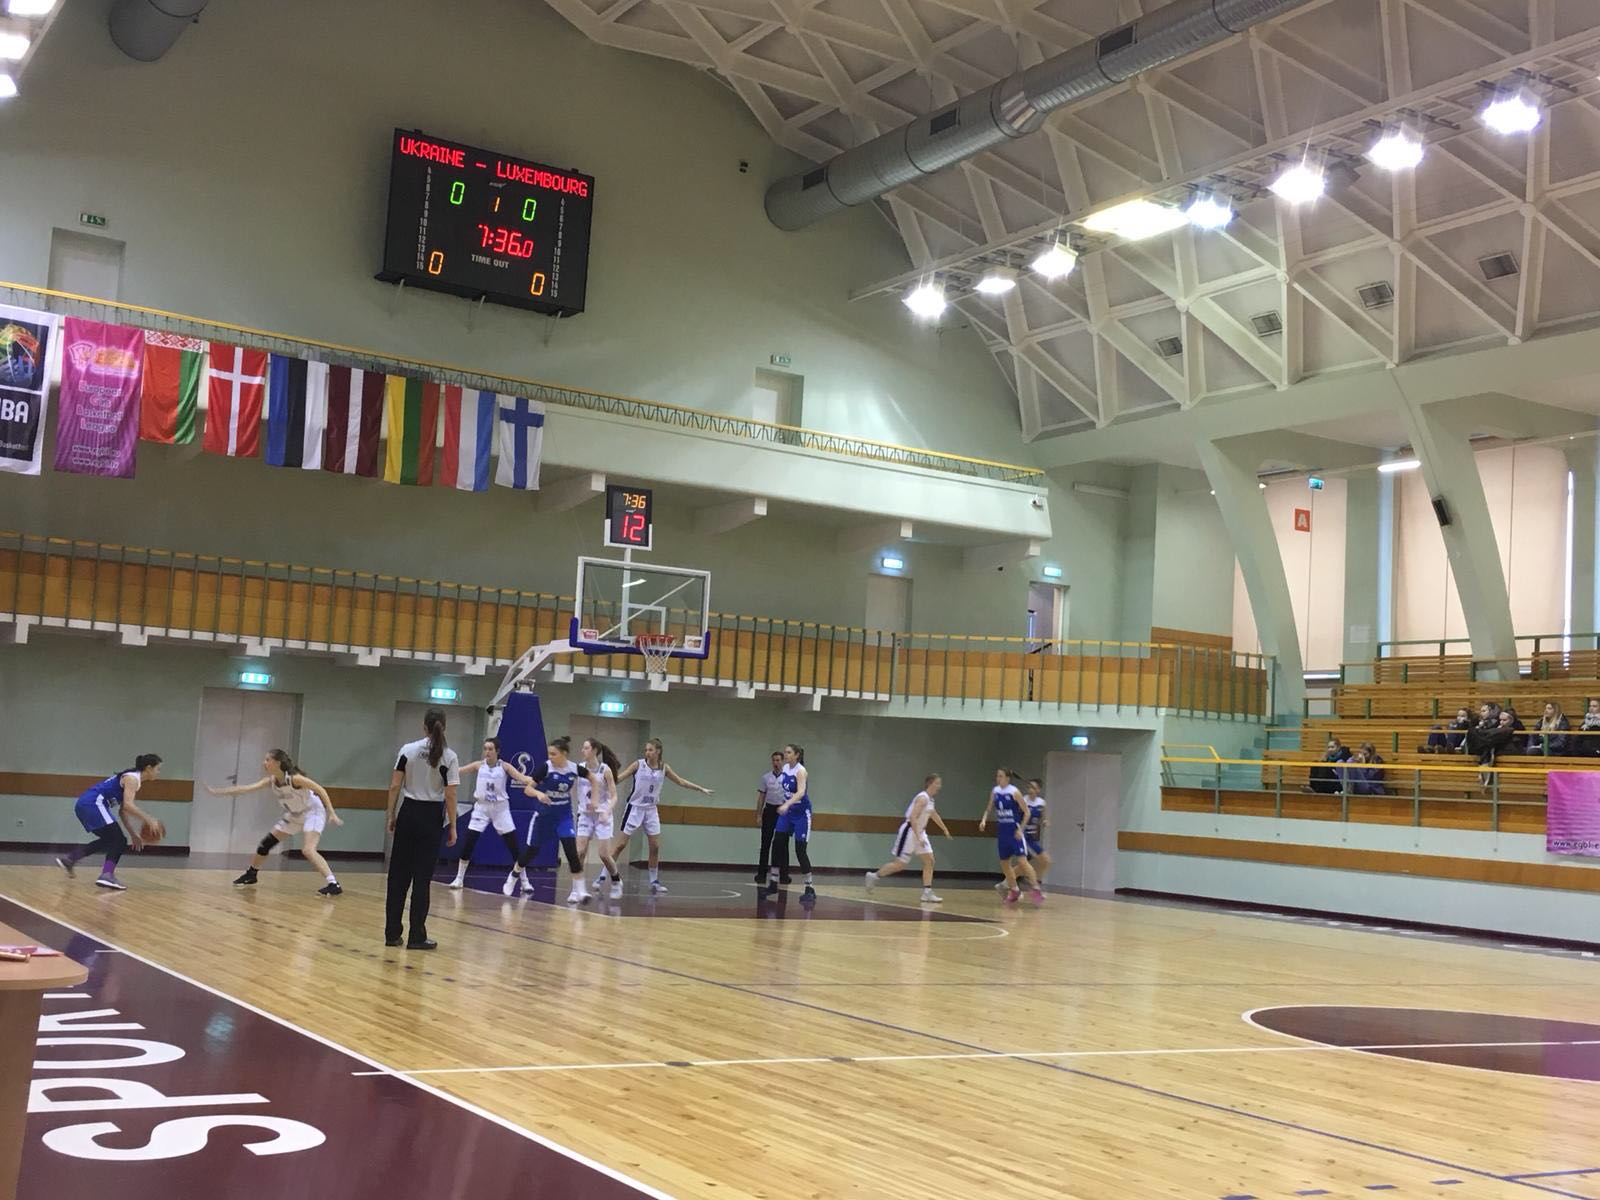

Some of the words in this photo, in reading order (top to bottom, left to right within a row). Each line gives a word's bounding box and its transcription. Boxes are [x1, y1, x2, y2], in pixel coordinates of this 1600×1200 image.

[400, 137, 465, 168] UKRAINE
[497, 161, 588, 198] LUXEMBOURG
[450, 181, 465, 205] 0
[494, 196, 501, 213] 1
[522, 198, 537, 222] 0
[428, 251, 444, 276] 0
[472, 253, 491, 265] TIME
[493, 259, 510, 269] OUT
[531, 273, 546, 297] 0
[0, 397, 30, 424] BA
[623, 493, 647, 509] 7:36
[622, 514, 646, 541] 12
[1298, 512, 1309, 528] A
